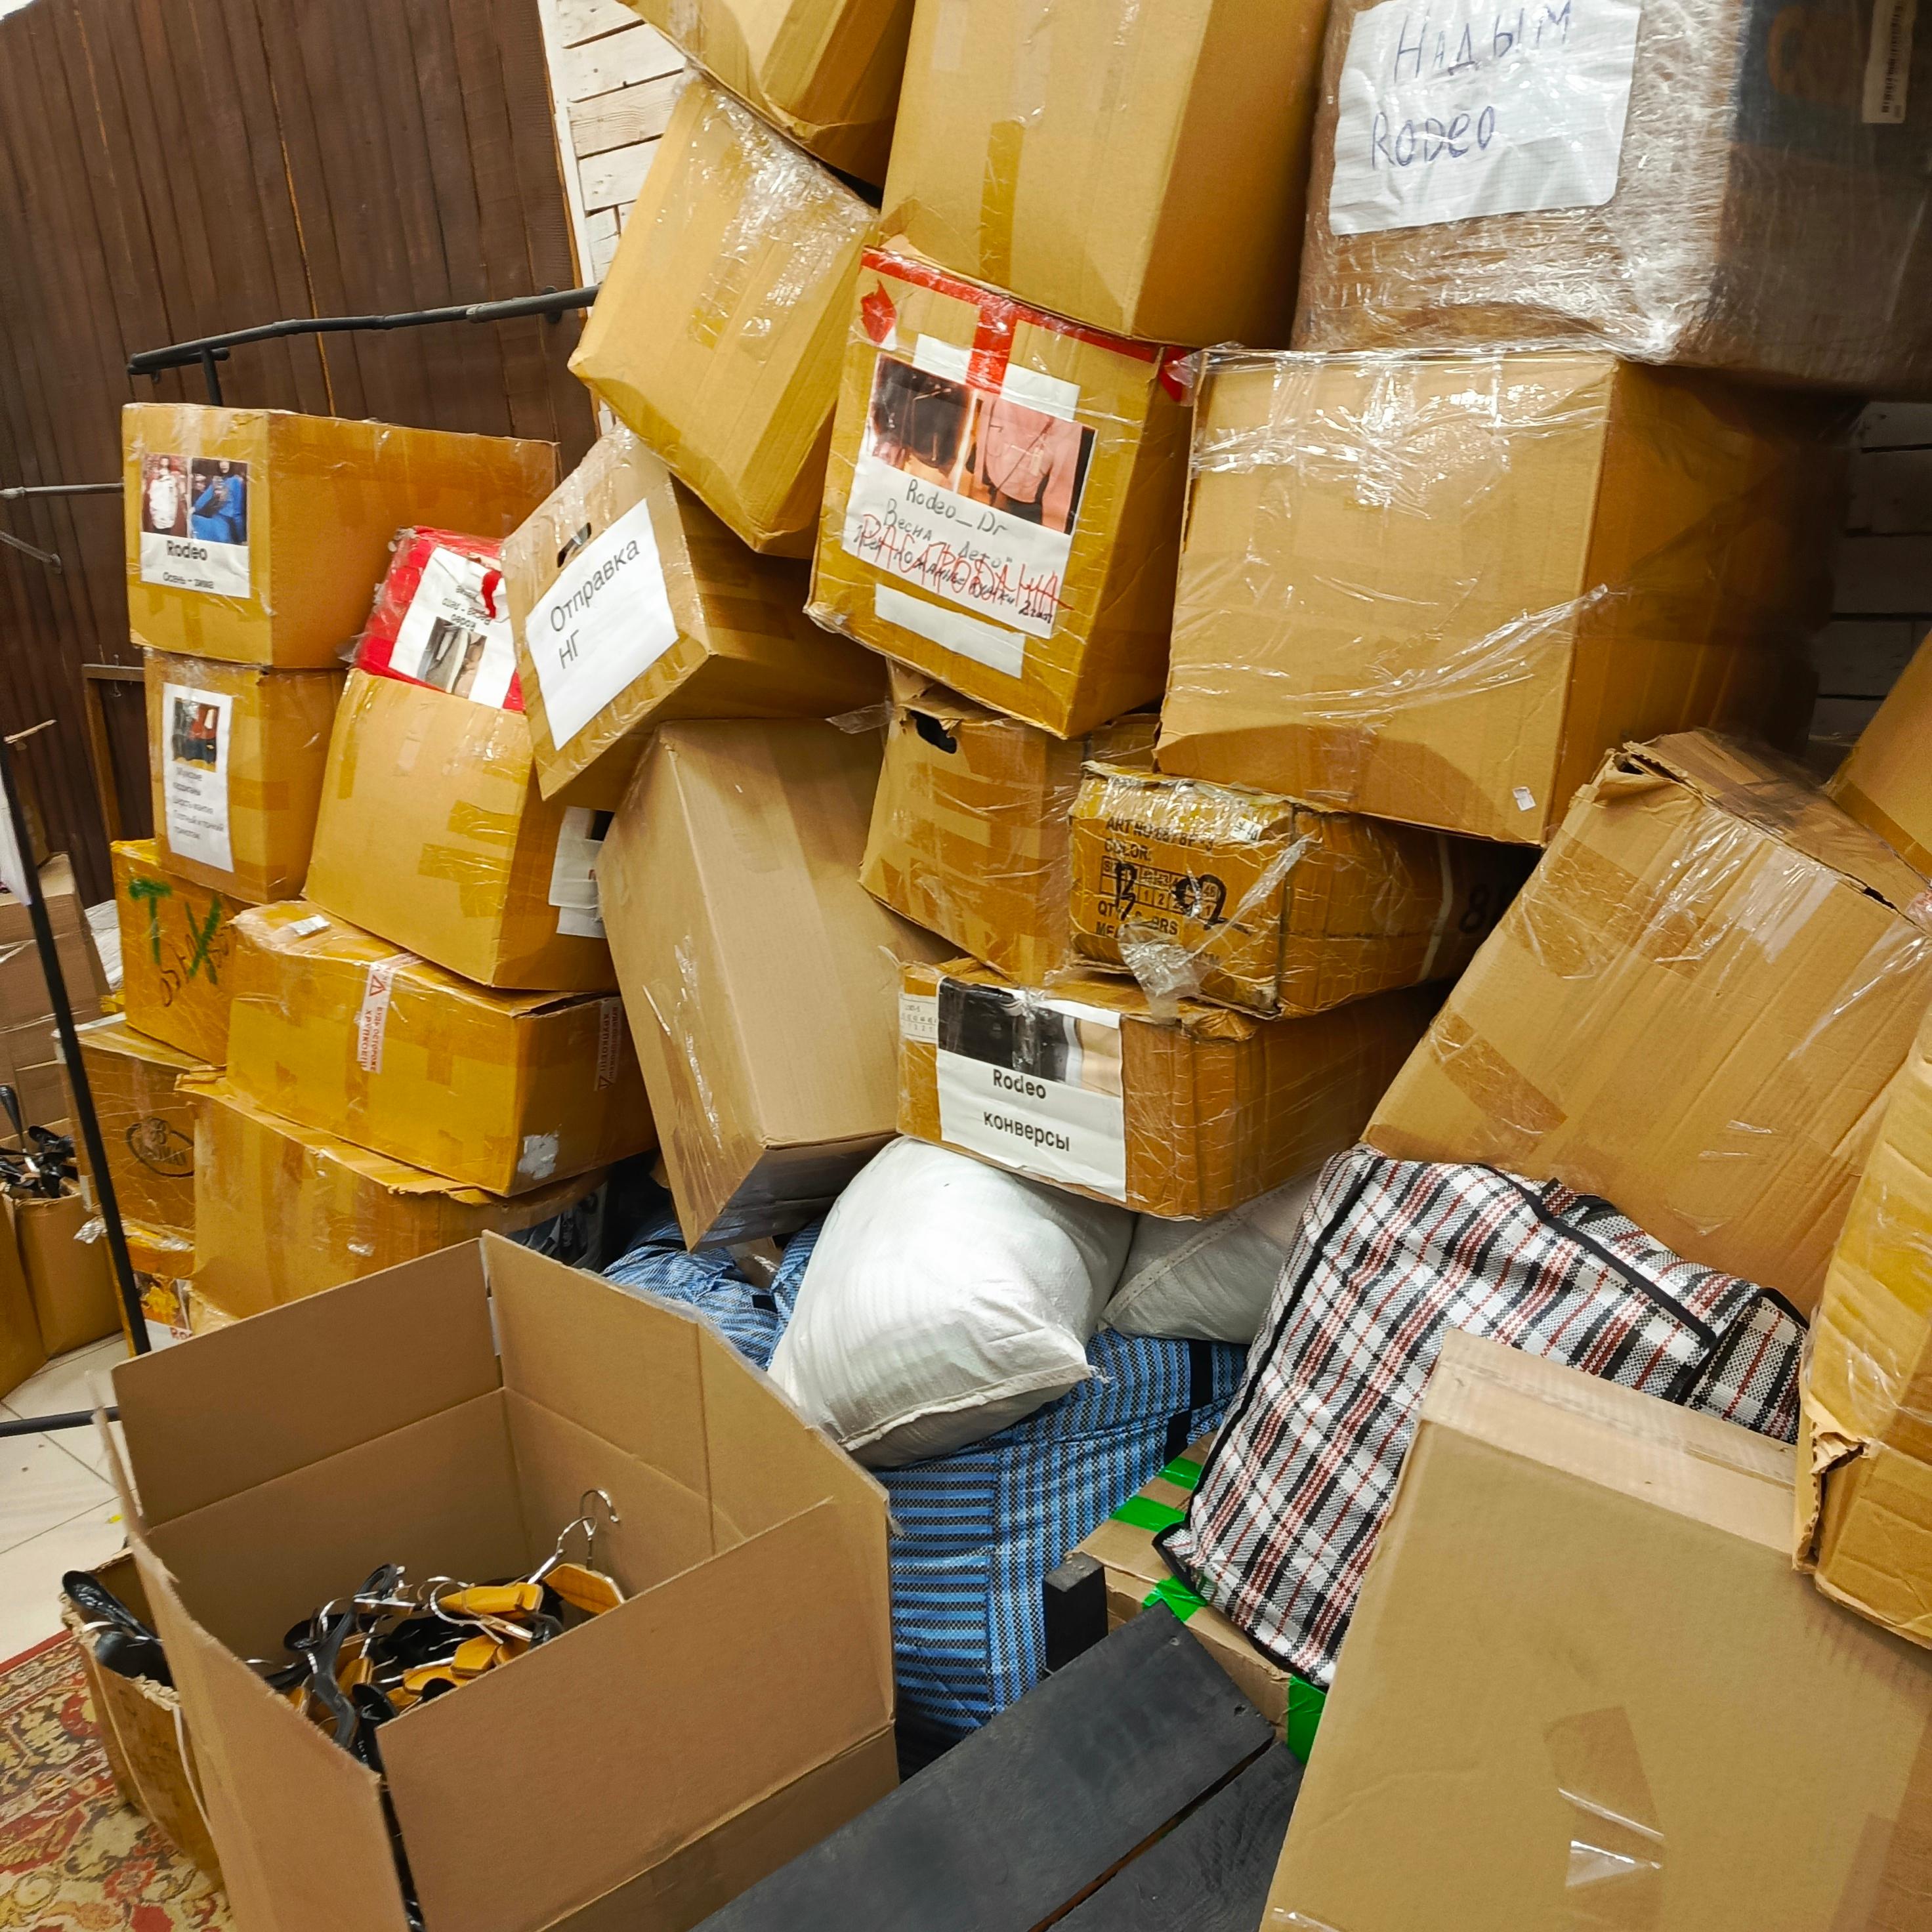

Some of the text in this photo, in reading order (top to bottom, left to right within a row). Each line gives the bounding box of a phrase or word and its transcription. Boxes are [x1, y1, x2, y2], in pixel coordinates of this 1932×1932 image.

[166, 539, 208, 560] Rodeo
[550, 539, 640, 632] Отправка
[558, 629, 580, 669] НГ
[992, 1068, 1047, 1099] Rodeo
[984, 1111, 1070, 1152] конверсы
